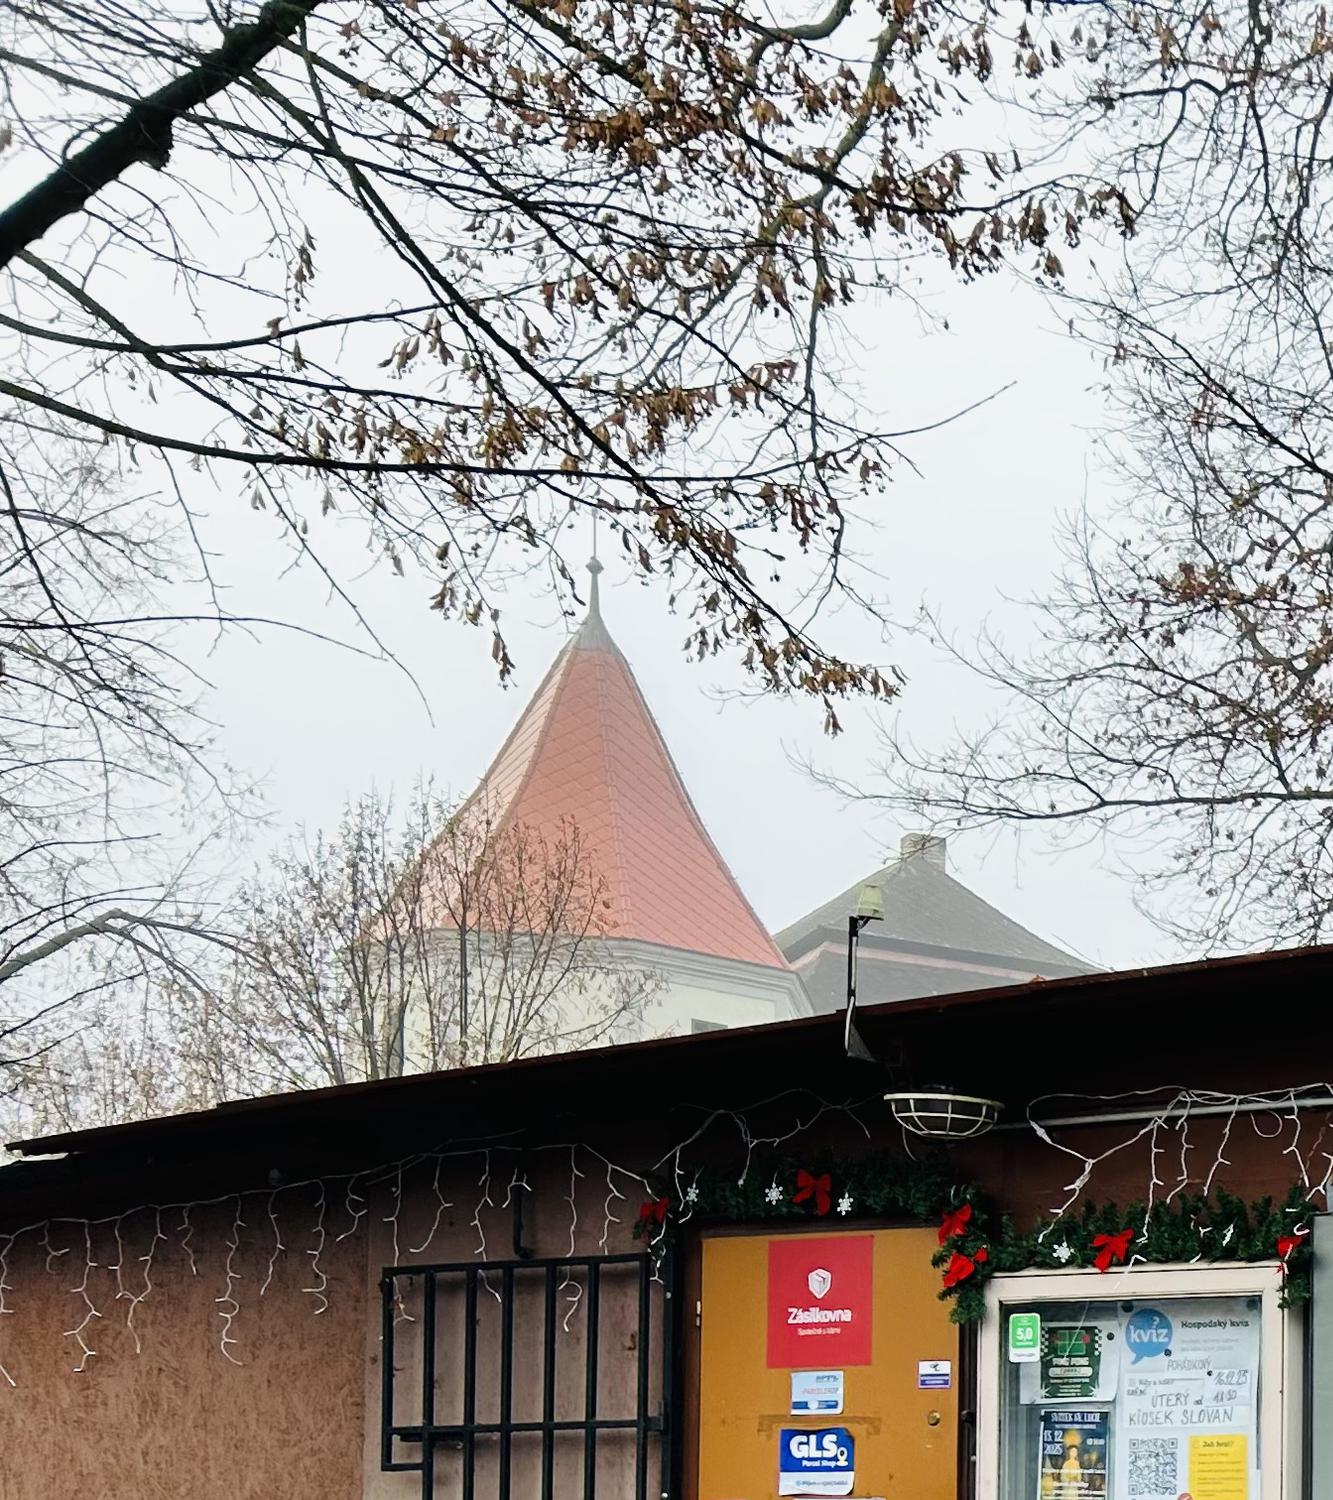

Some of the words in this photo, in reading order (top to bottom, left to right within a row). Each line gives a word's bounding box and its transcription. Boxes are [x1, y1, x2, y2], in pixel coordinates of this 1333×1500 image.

[787, 1307, 852, 1325] Zásilkovna
[1181, 1407, 1234, 1425] SLOVAN
[789, 1434, 837, 1459] GLS
[802, 1459, 820, 1468] Parcel
[821, 1459, 837, 1469] Shop
